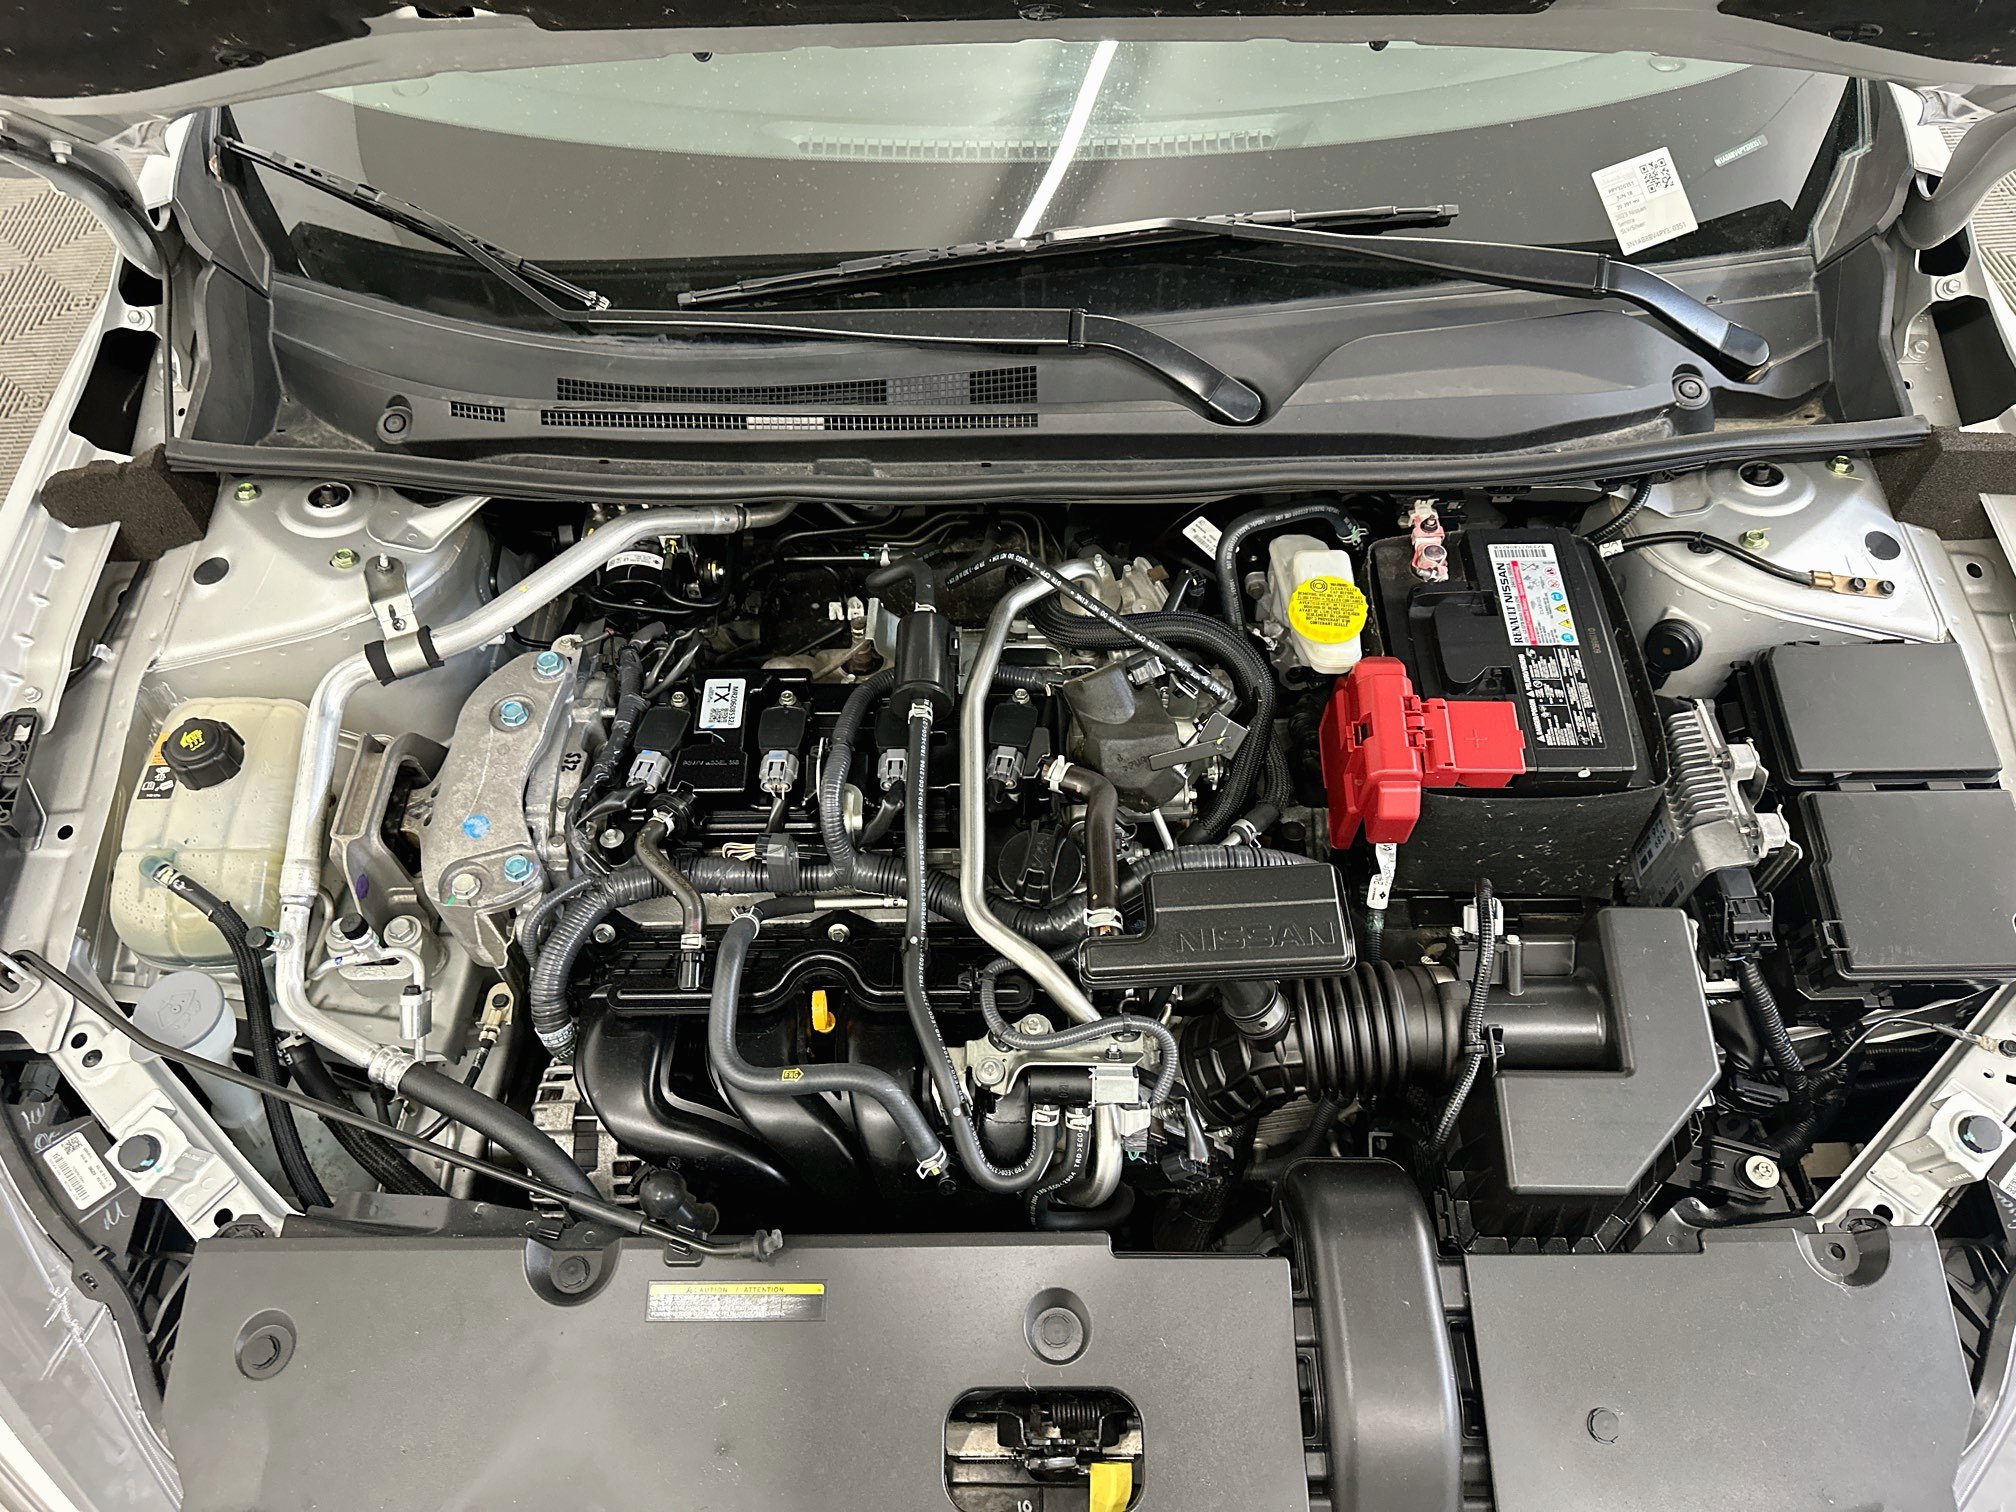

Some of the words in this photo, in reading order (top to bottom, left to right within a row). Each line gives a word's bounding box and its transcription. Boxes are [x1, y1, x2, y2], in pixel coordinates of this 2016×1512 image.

[1496, 562, 1514, 603] NISSAN
[1506, 606, 1524, 643] RENAULT
[714, 683, 731, 702] TX
[1176, 922, 1336, 952] NISSAN
